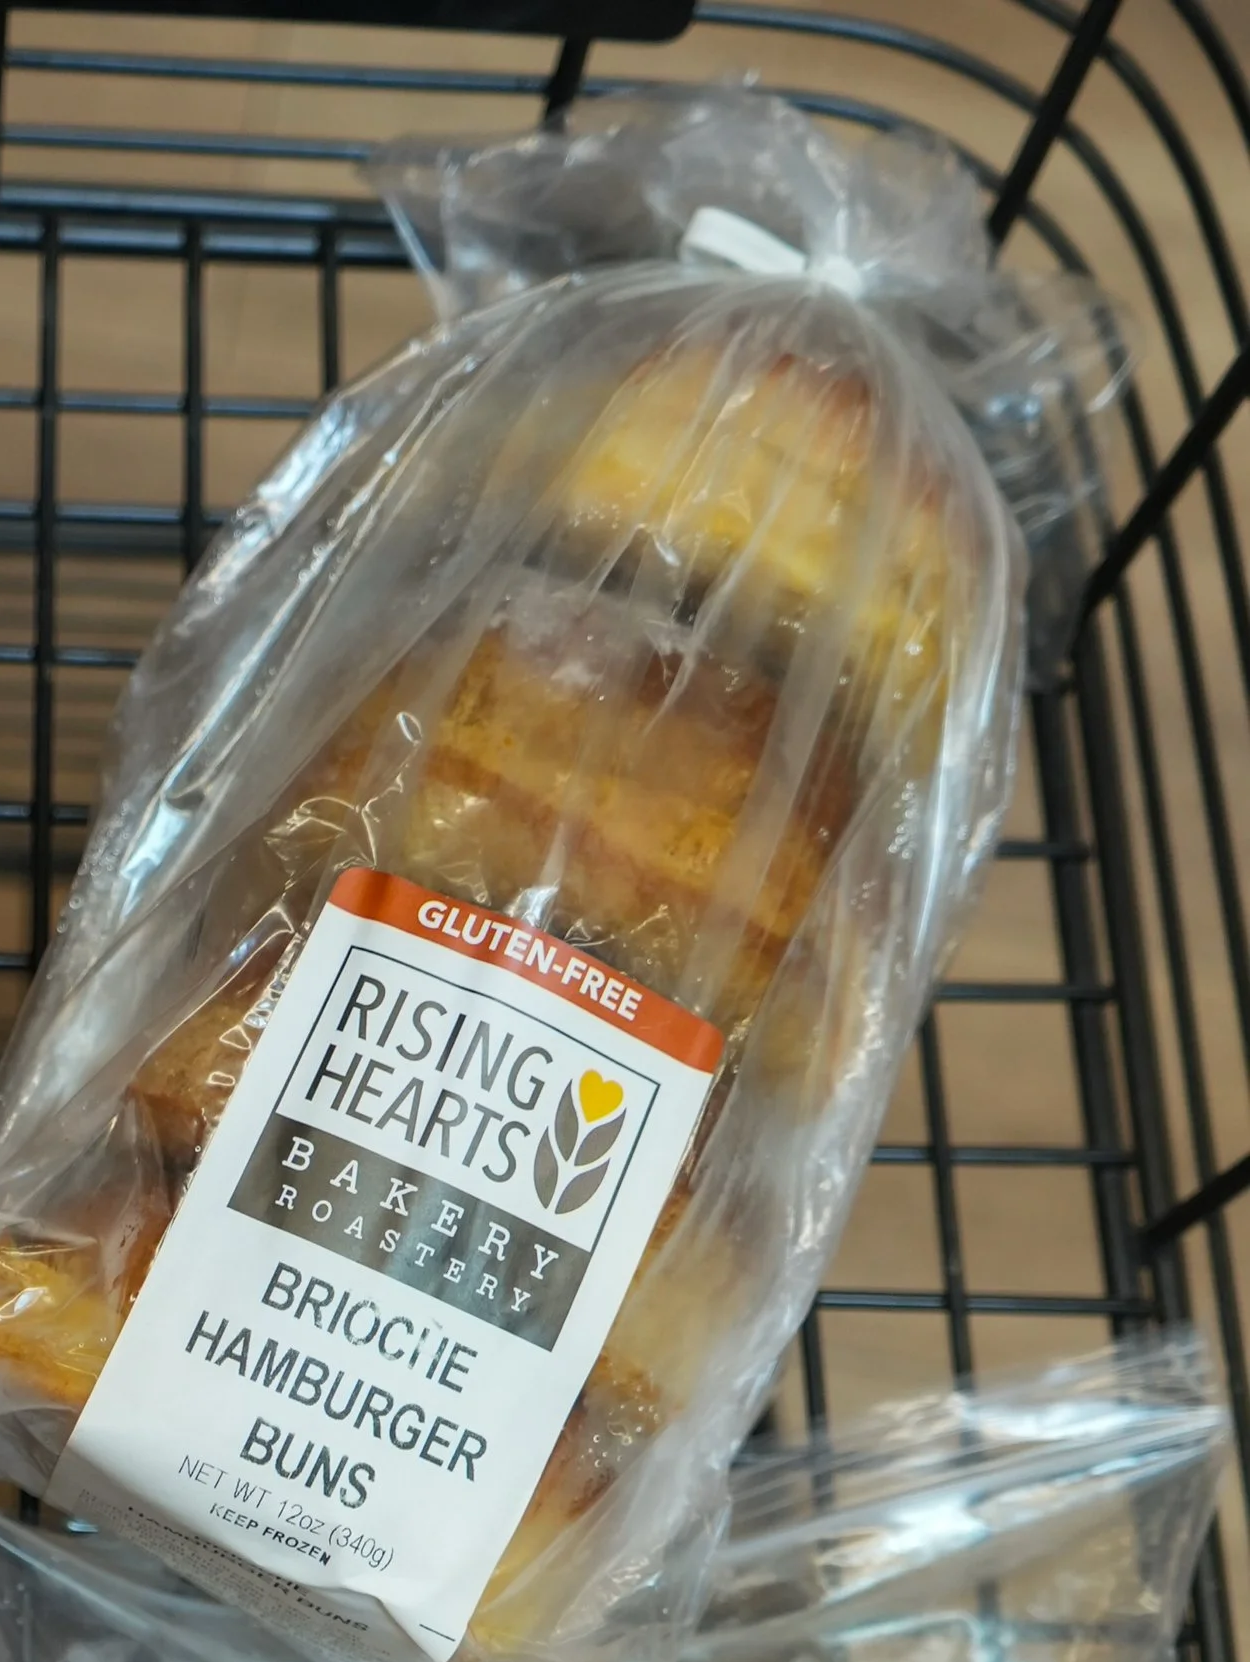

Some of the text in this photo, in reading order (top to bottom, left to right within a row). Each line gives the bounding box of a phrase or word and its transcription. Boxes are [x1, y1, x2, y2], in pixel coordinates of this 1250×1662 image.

[417, 899, 643, 1022] GLUTEN-FREE
[336, 973, 554, 1112] RISING
[304, 1044, 531, 1184] HEARTS
[275, 1184, 532, 1313] ROASTERY
[281, 1136, 559, 1280] BAKERY
[261, 1262, 479, 1394] BRIOCHE
[185, 1310, 488, 1482] HAMBURGER
[178, 1455, 228, 1489] NET
[233, 1478, 272, 1508] WT
[277, 1500, 325, 1535] 12oz
[328, 1524, 394, 1571] (340g)
[239, 1417, 377, 1509] BUNS
[210, 1503, 258, 1530] KEEP
[262, 1527, 331, 1566] FROZEN
